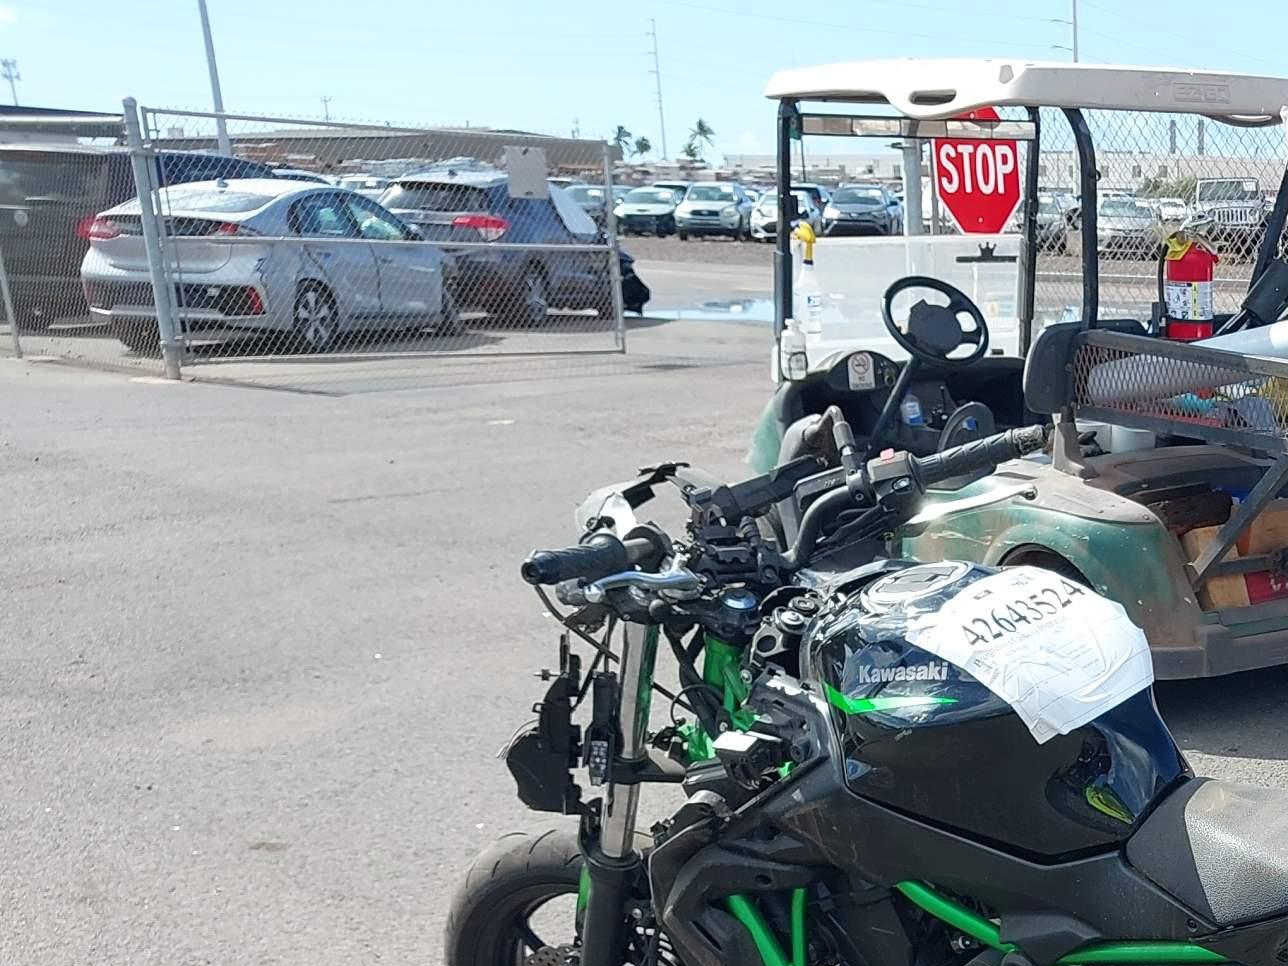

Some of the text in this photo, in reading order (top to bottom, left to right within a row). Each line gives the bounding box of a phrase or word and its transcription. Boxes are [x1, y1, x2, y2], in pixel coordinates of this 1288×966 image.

[939, 143, 1015, 195] STOP
[962, 579, 1085, 646] 42643524
[859, 661, 949, 684] Kawasaki
